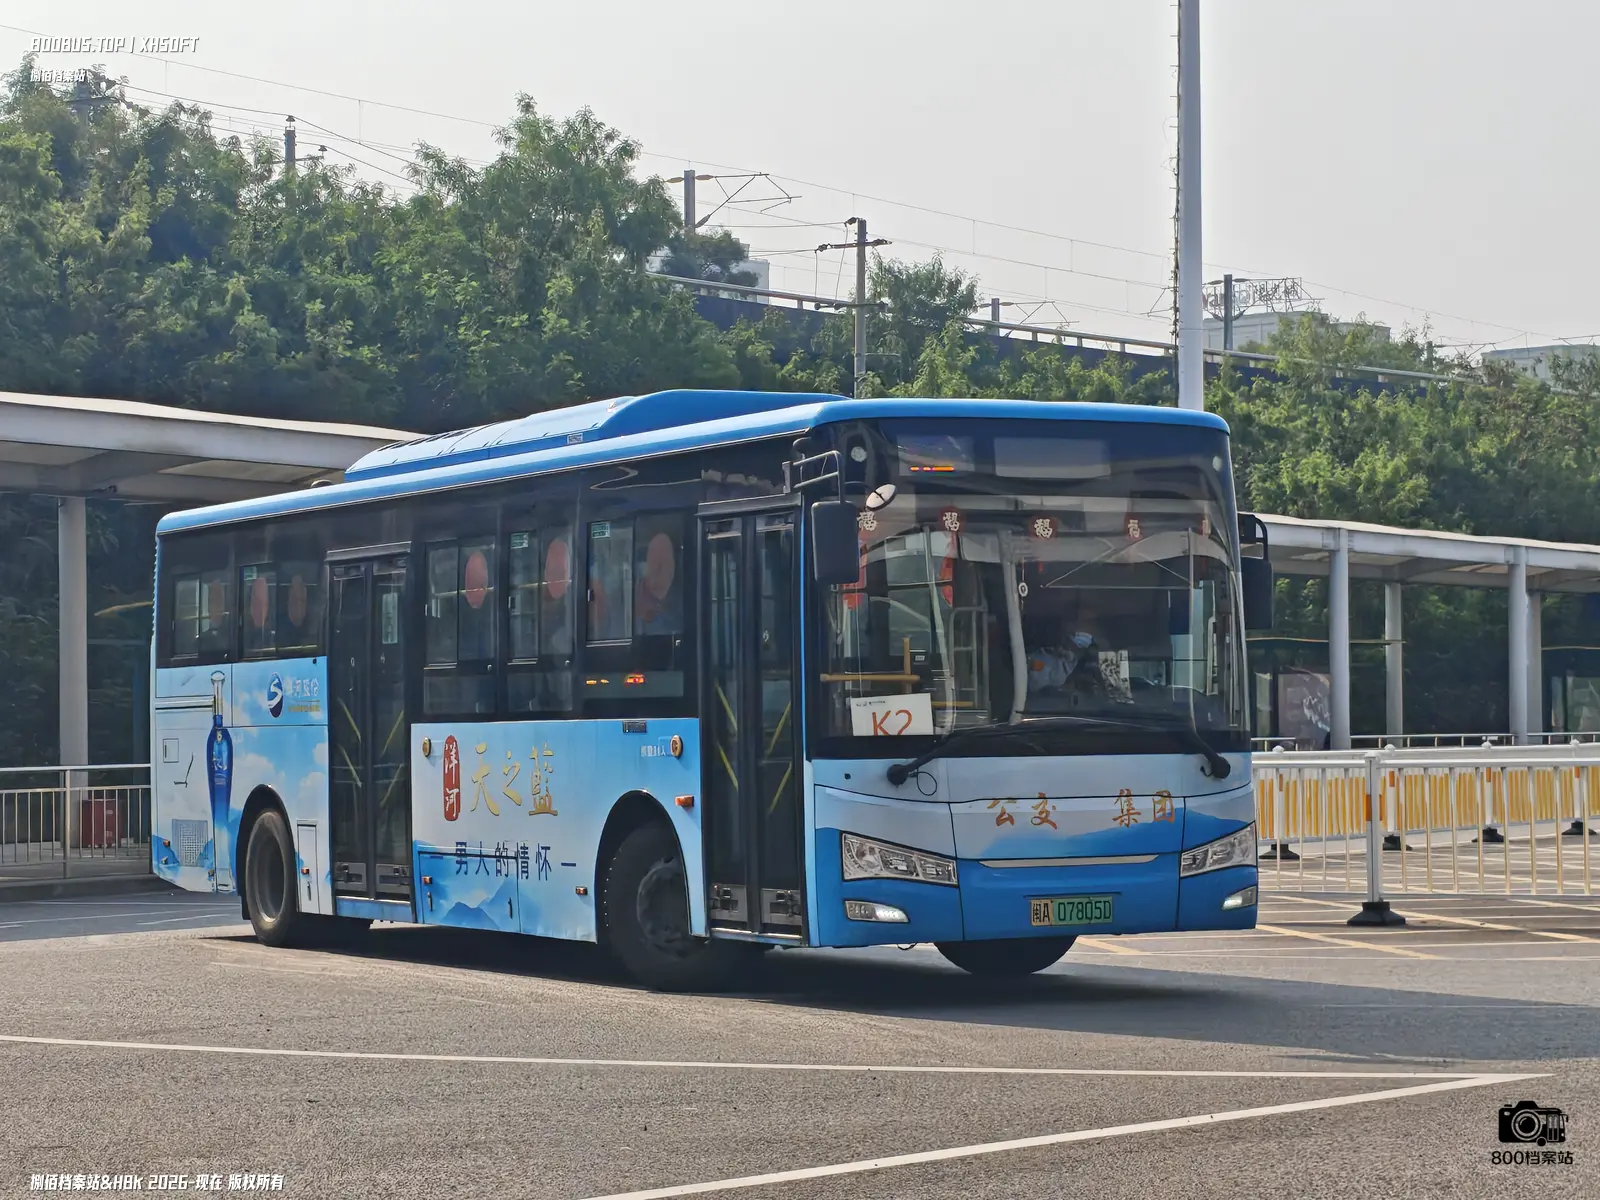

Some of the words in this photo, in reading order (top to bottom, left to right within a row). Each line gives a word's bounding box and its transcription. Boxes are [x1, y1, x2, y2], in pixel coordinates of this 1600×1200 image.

[871, 709, 913, 736] K2
[444, 741, 460, 818] 洋河
[986, 792, 1058, 830] 公交
